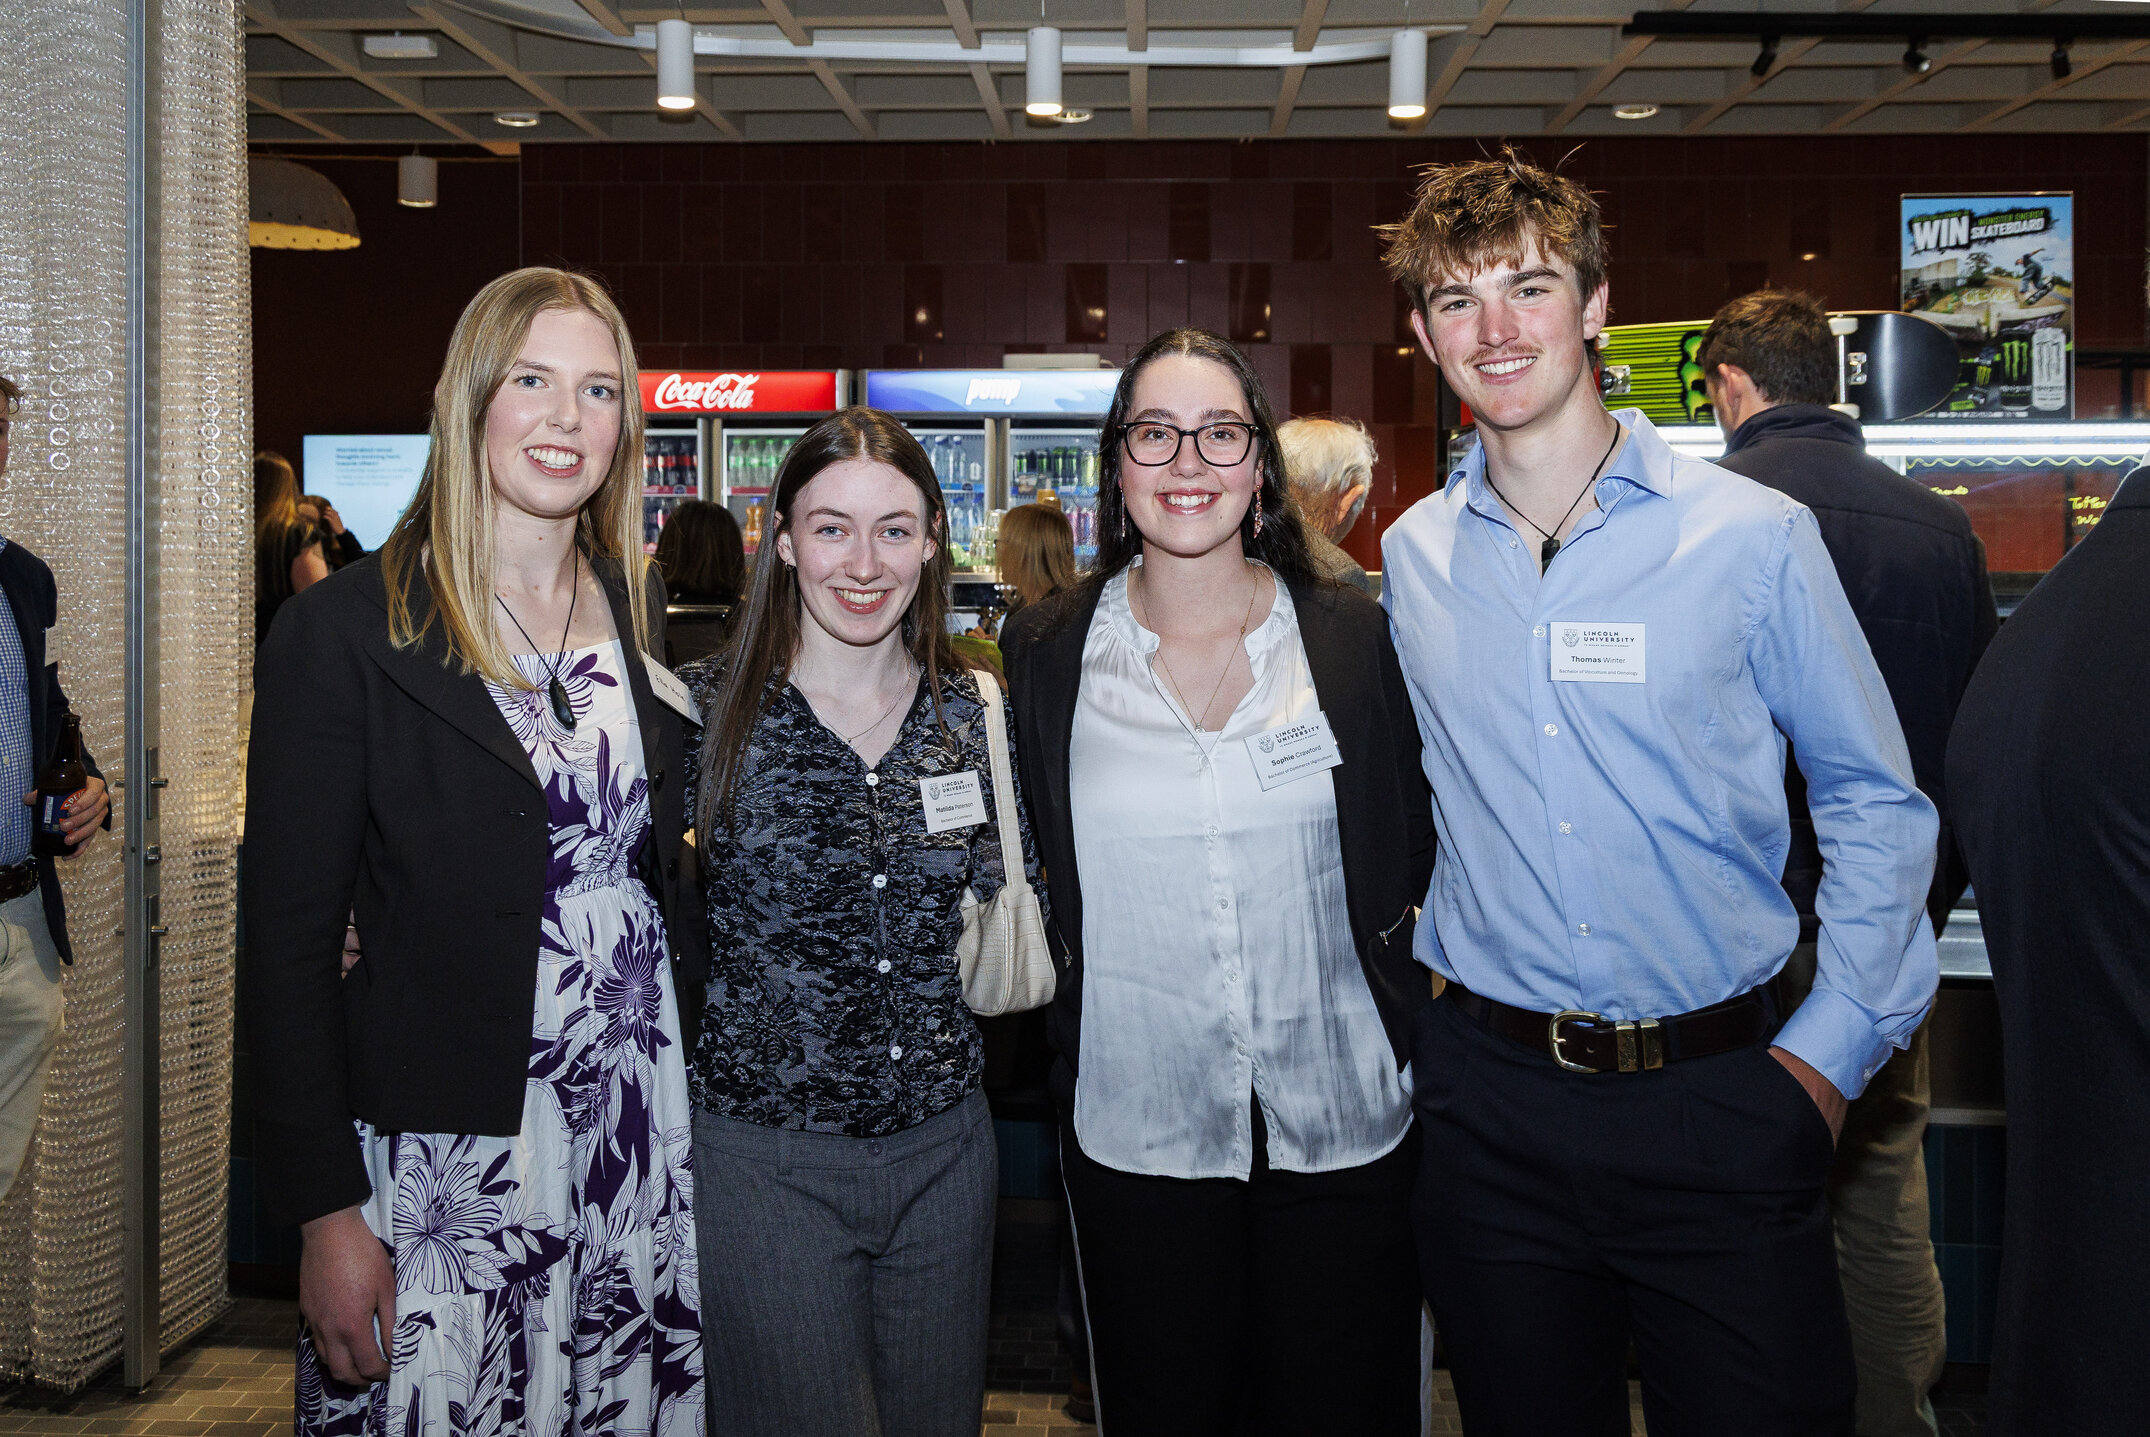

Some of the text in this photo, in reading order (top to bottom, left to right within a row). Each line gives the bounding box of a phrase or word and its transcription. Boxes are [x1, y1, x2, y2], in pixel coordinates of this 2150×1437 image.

[1913, 216, 1970, 250] WIN
[1970, 218, 2046, 240] SKATEBOARD
[654, 373, 760, 409] Coca-Cola
[965, 378, 1022, 406] pump
[2068, 495, 2107, 510] Toffee
[1571, 655, 1602, 663] Thomas
[1275, 724, 1305, 739] LINCOLN
[1277, 725, 1320, 743] UNIVERSITY
[1271, 745, 1322, 766] Sophie Crawford
[942, 780, 964, 788] LINCOLN
[942, 783, 974, 793] UNIVERSITY
